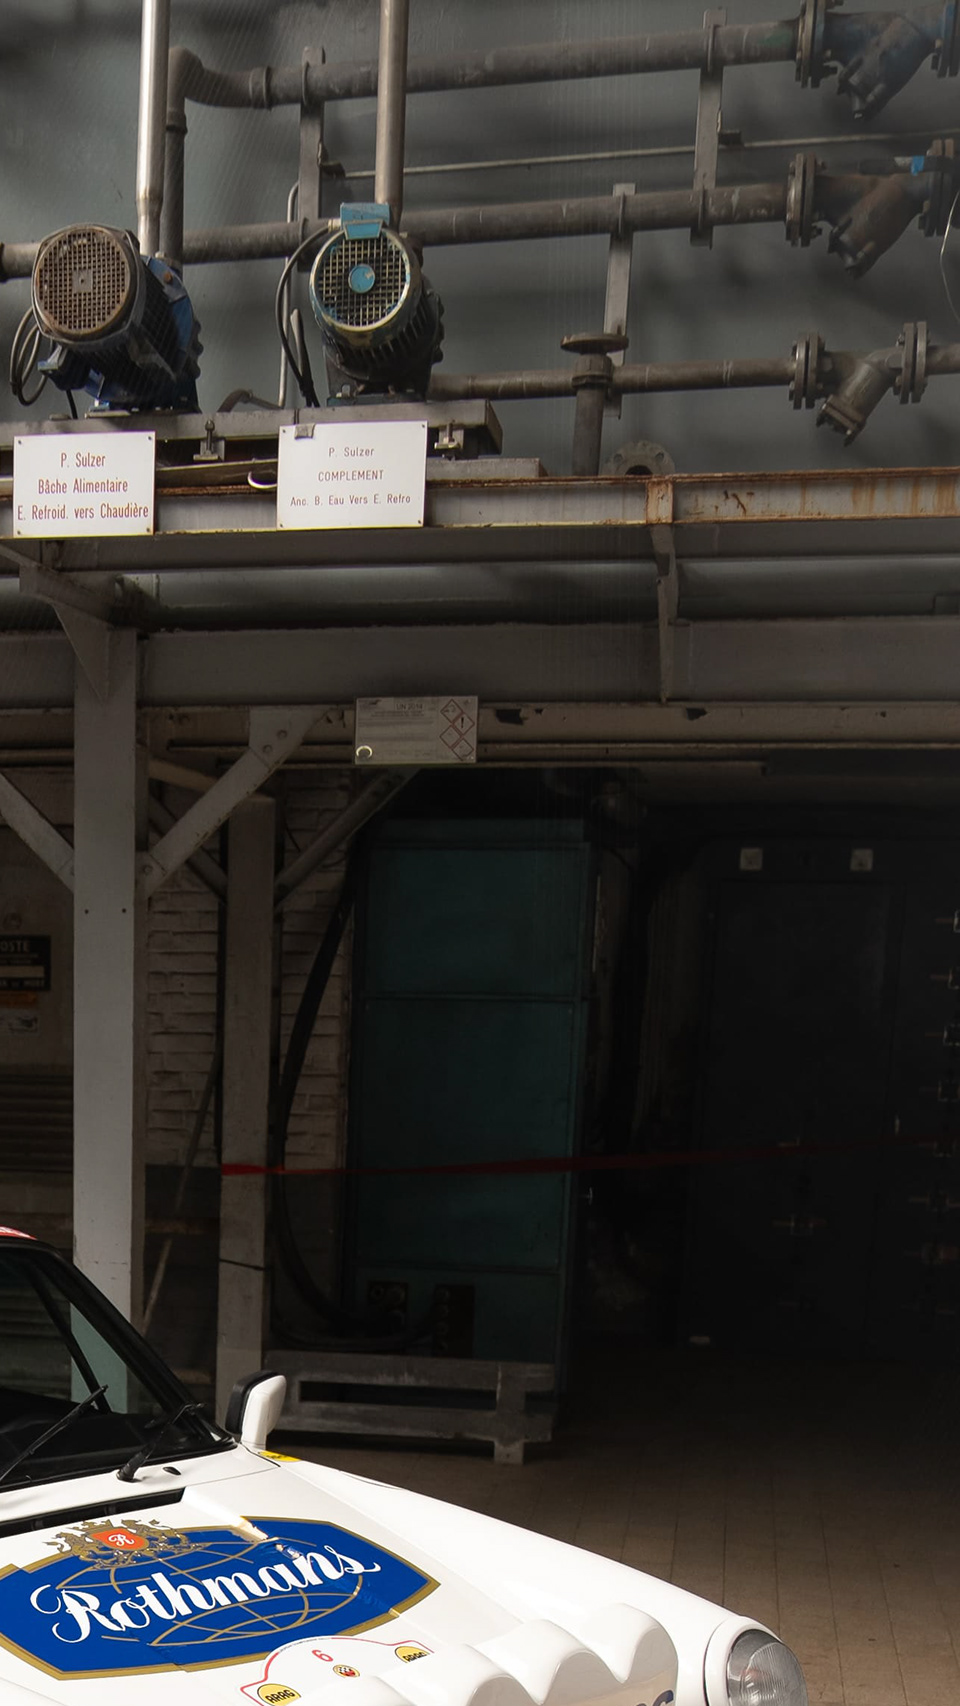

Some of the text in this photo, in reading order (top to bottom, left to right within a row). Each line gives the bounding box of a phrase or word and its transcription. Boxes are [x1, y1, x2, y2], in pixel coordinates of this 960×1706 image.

[60, 451, 106, 468] P. Sulzer
[329, 446, 375, 458] P. Sulzer
[318, 469, 384, 482] COMPLEMENT
[38, 477, 129, 495] Bâche Alimentaire
[314, 496, 323, 506] B.
[328, 495, 345, 506] Eau
[349, 494, 369, 505] Vers
[373, 493, 382, 505] E.
[387, 493, 411, 504] Refro
[17, 502, 149, 521] E. Refroid. vers Chaudière
[29, 1545, 382, 1644] Rothmans
[311, 1649, 334, 1662] 6
[264, 1688, 296, 1704] ARAG
